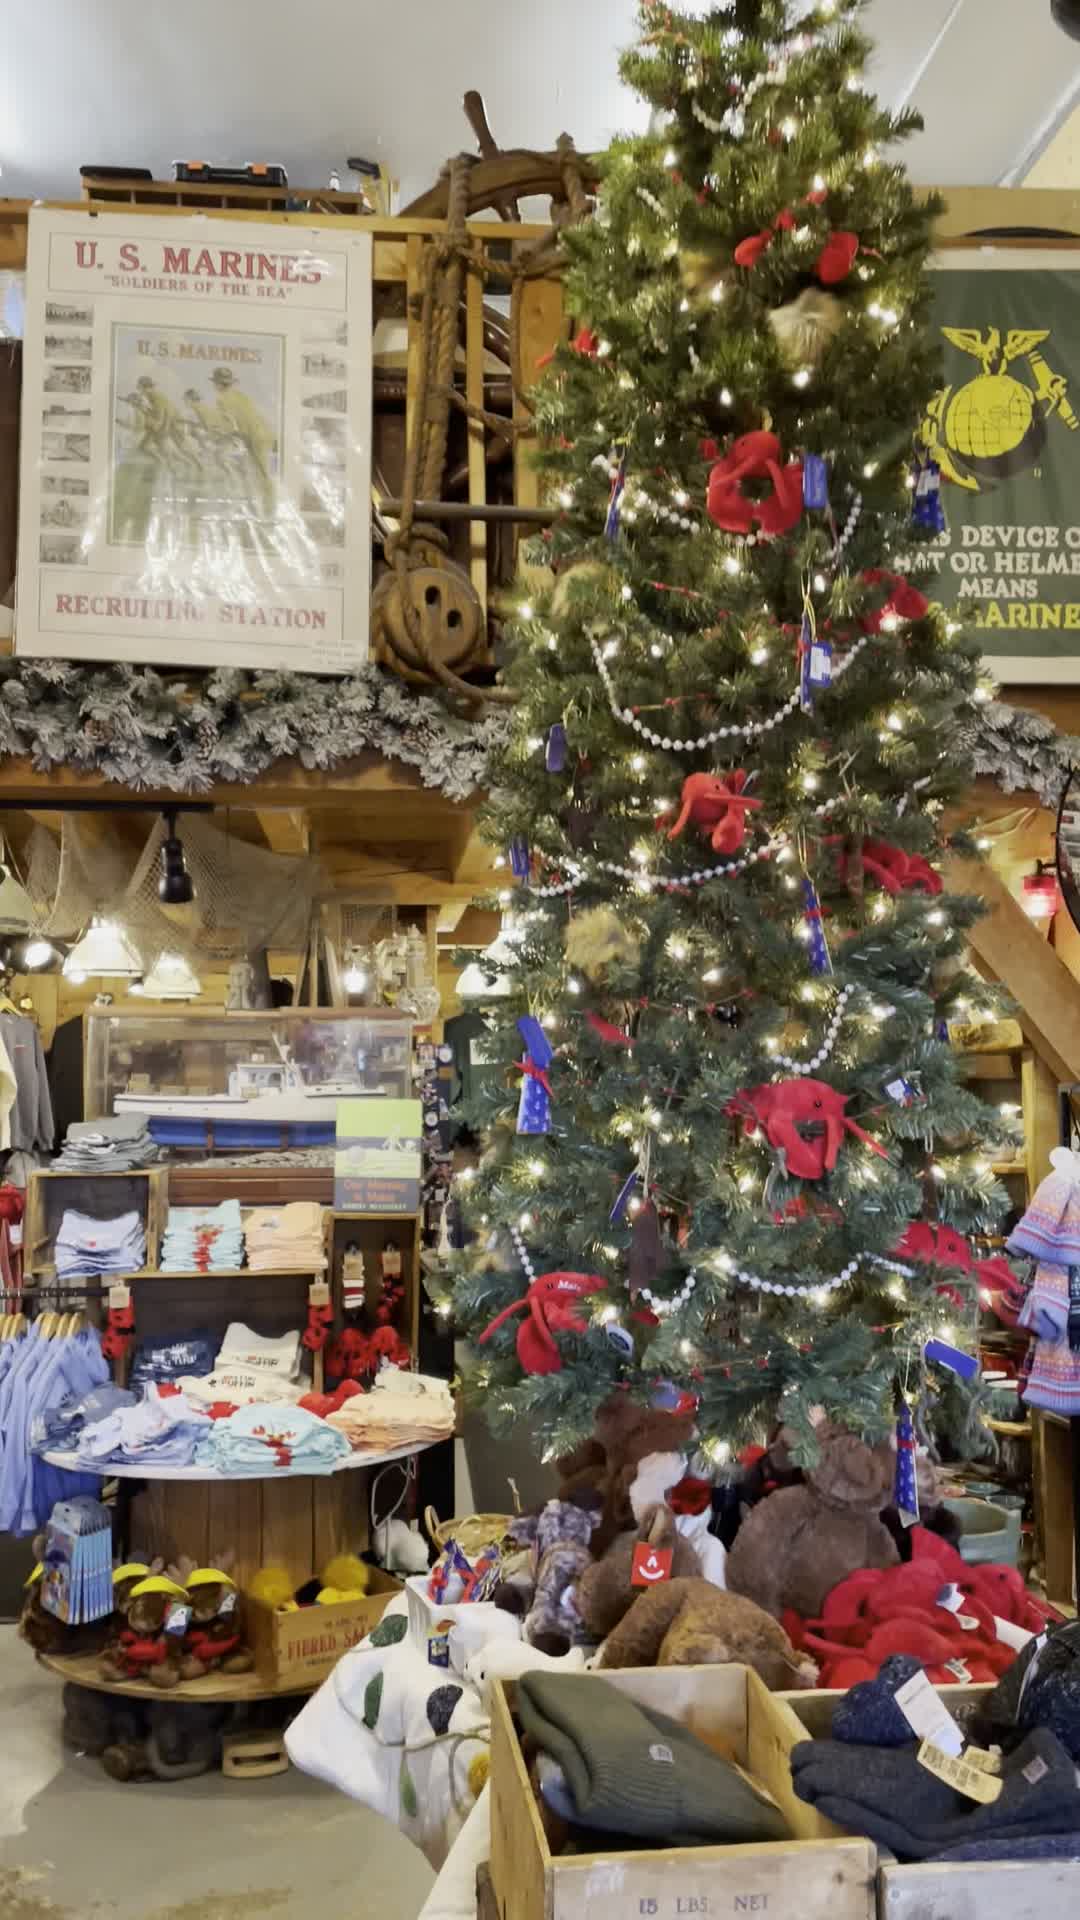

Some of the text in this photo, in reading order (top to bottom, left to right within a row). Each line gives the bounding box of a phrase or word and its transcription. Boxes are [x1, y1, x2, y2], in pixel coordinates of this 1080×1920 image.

[75, 241, 322, 284] U. S. MARINES
[194, 280, 212, 293] OF
[961, 525, 1059, 548] DEVICE
[1065, 526, 1080, 548] O
[950, 552, 988, 574] OR
[958, 577, 1038, 599] MEANS
[218, 604, 327, 630] STATION
[733, 1893, 772, 1913] NET
